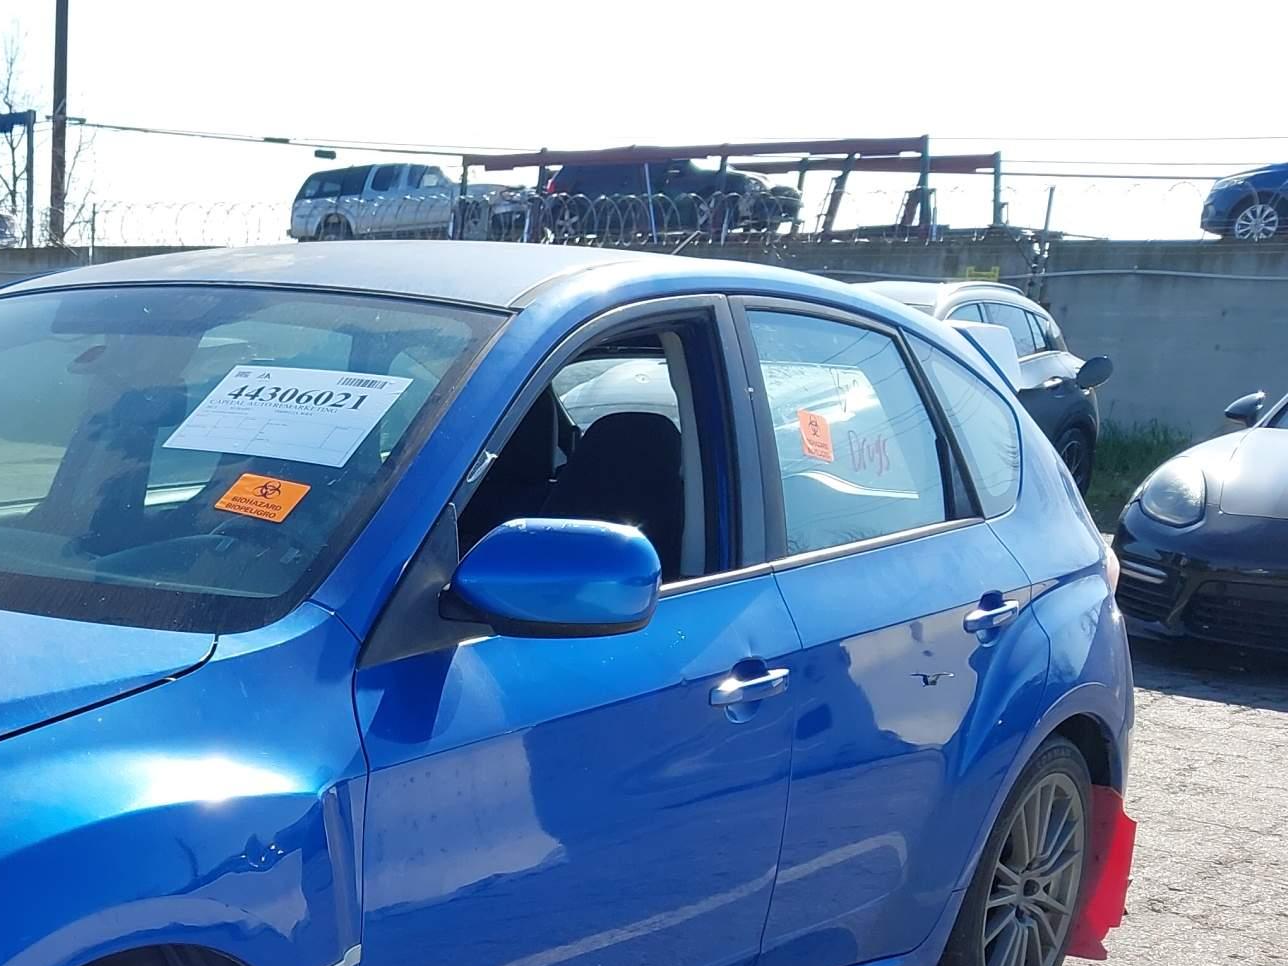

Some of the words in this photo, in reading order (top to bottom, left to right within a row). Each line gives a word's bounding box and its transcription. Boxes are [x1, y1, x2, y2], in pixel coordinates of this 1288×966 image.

[227, 384, 369, 410] 44306021
[225, 502, 277, 519] BIOPELIGRO
[231, 496, 282, 511] BIOHAZARD
